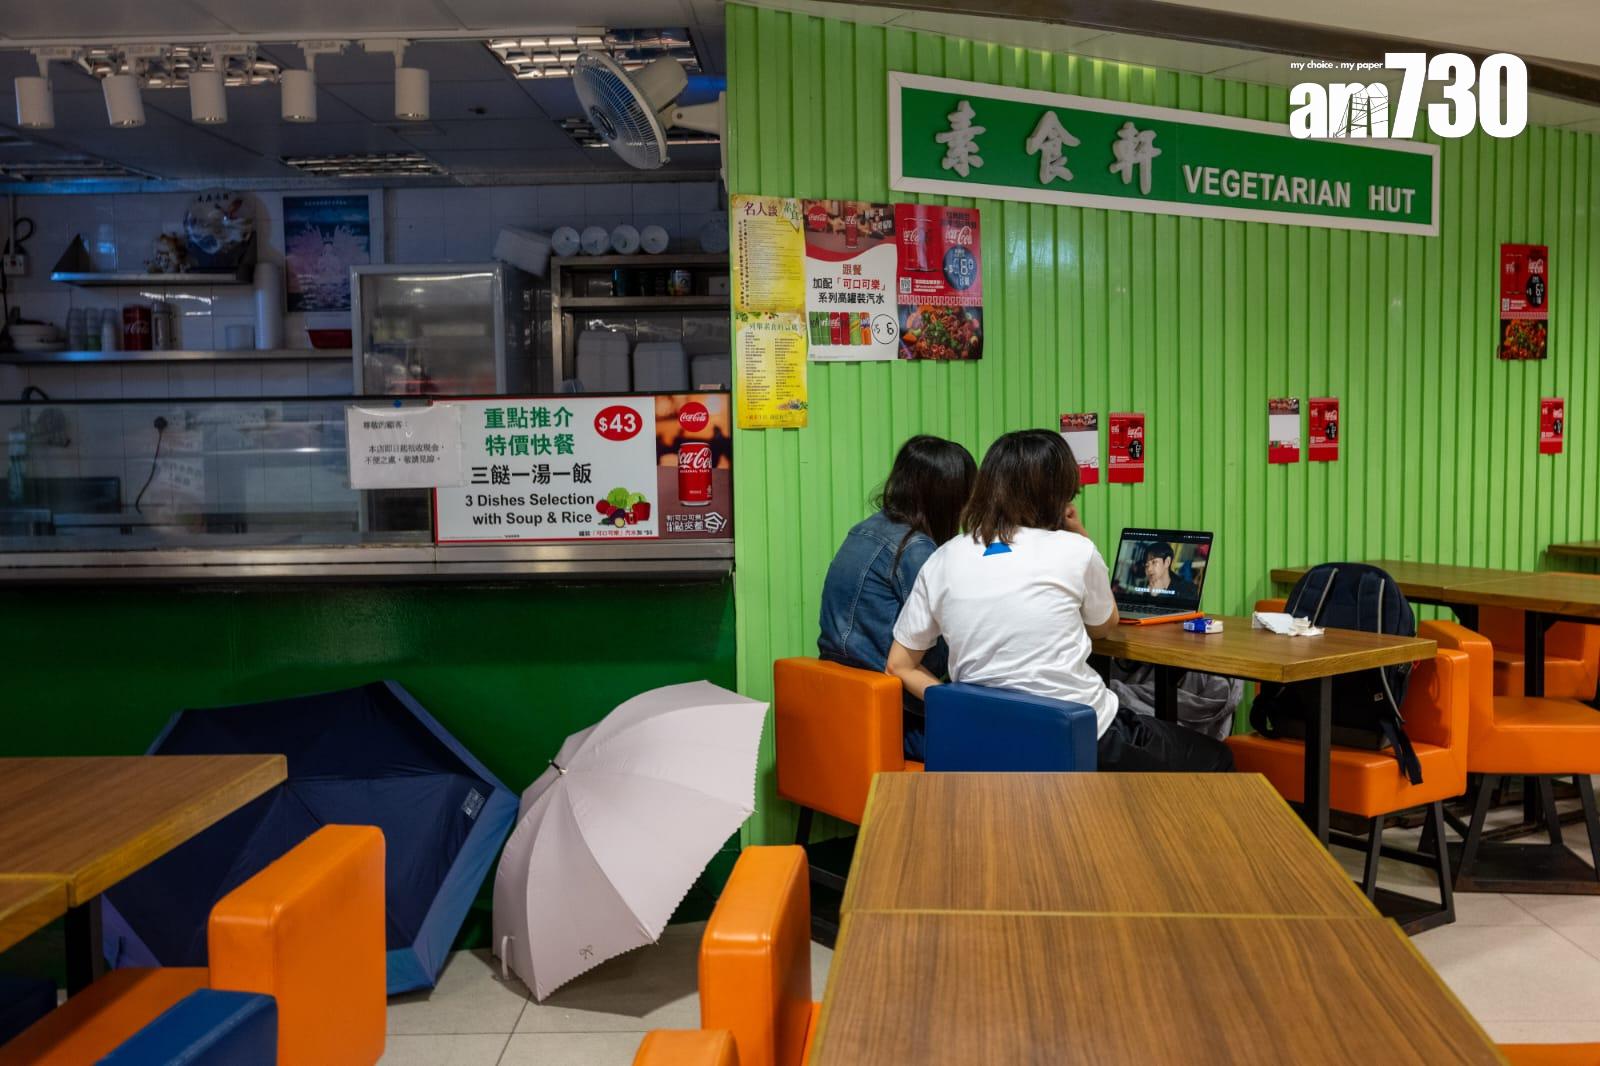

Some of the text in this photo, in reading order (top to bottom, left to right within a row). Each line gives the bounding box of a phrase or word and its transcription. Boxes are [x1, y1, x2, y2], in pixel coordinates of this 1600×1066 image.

[935, 99, 1161, 196] 素食軒
[1182, 163, 1415, 215] VEGETARIAN HUT
[842, 263, 862, 275] 跟餐
[484, 405, 574, 429] 重點推介
[599, 413, 637, 433] $43
[485, 433, 575, 457] 特價快餐
[470, 462, 593, 486] 三餸一湯一飯
[465, 492, 595, 507] 3 Dishes Selection
[472, 510, 593, 528] with Soup & Rice
